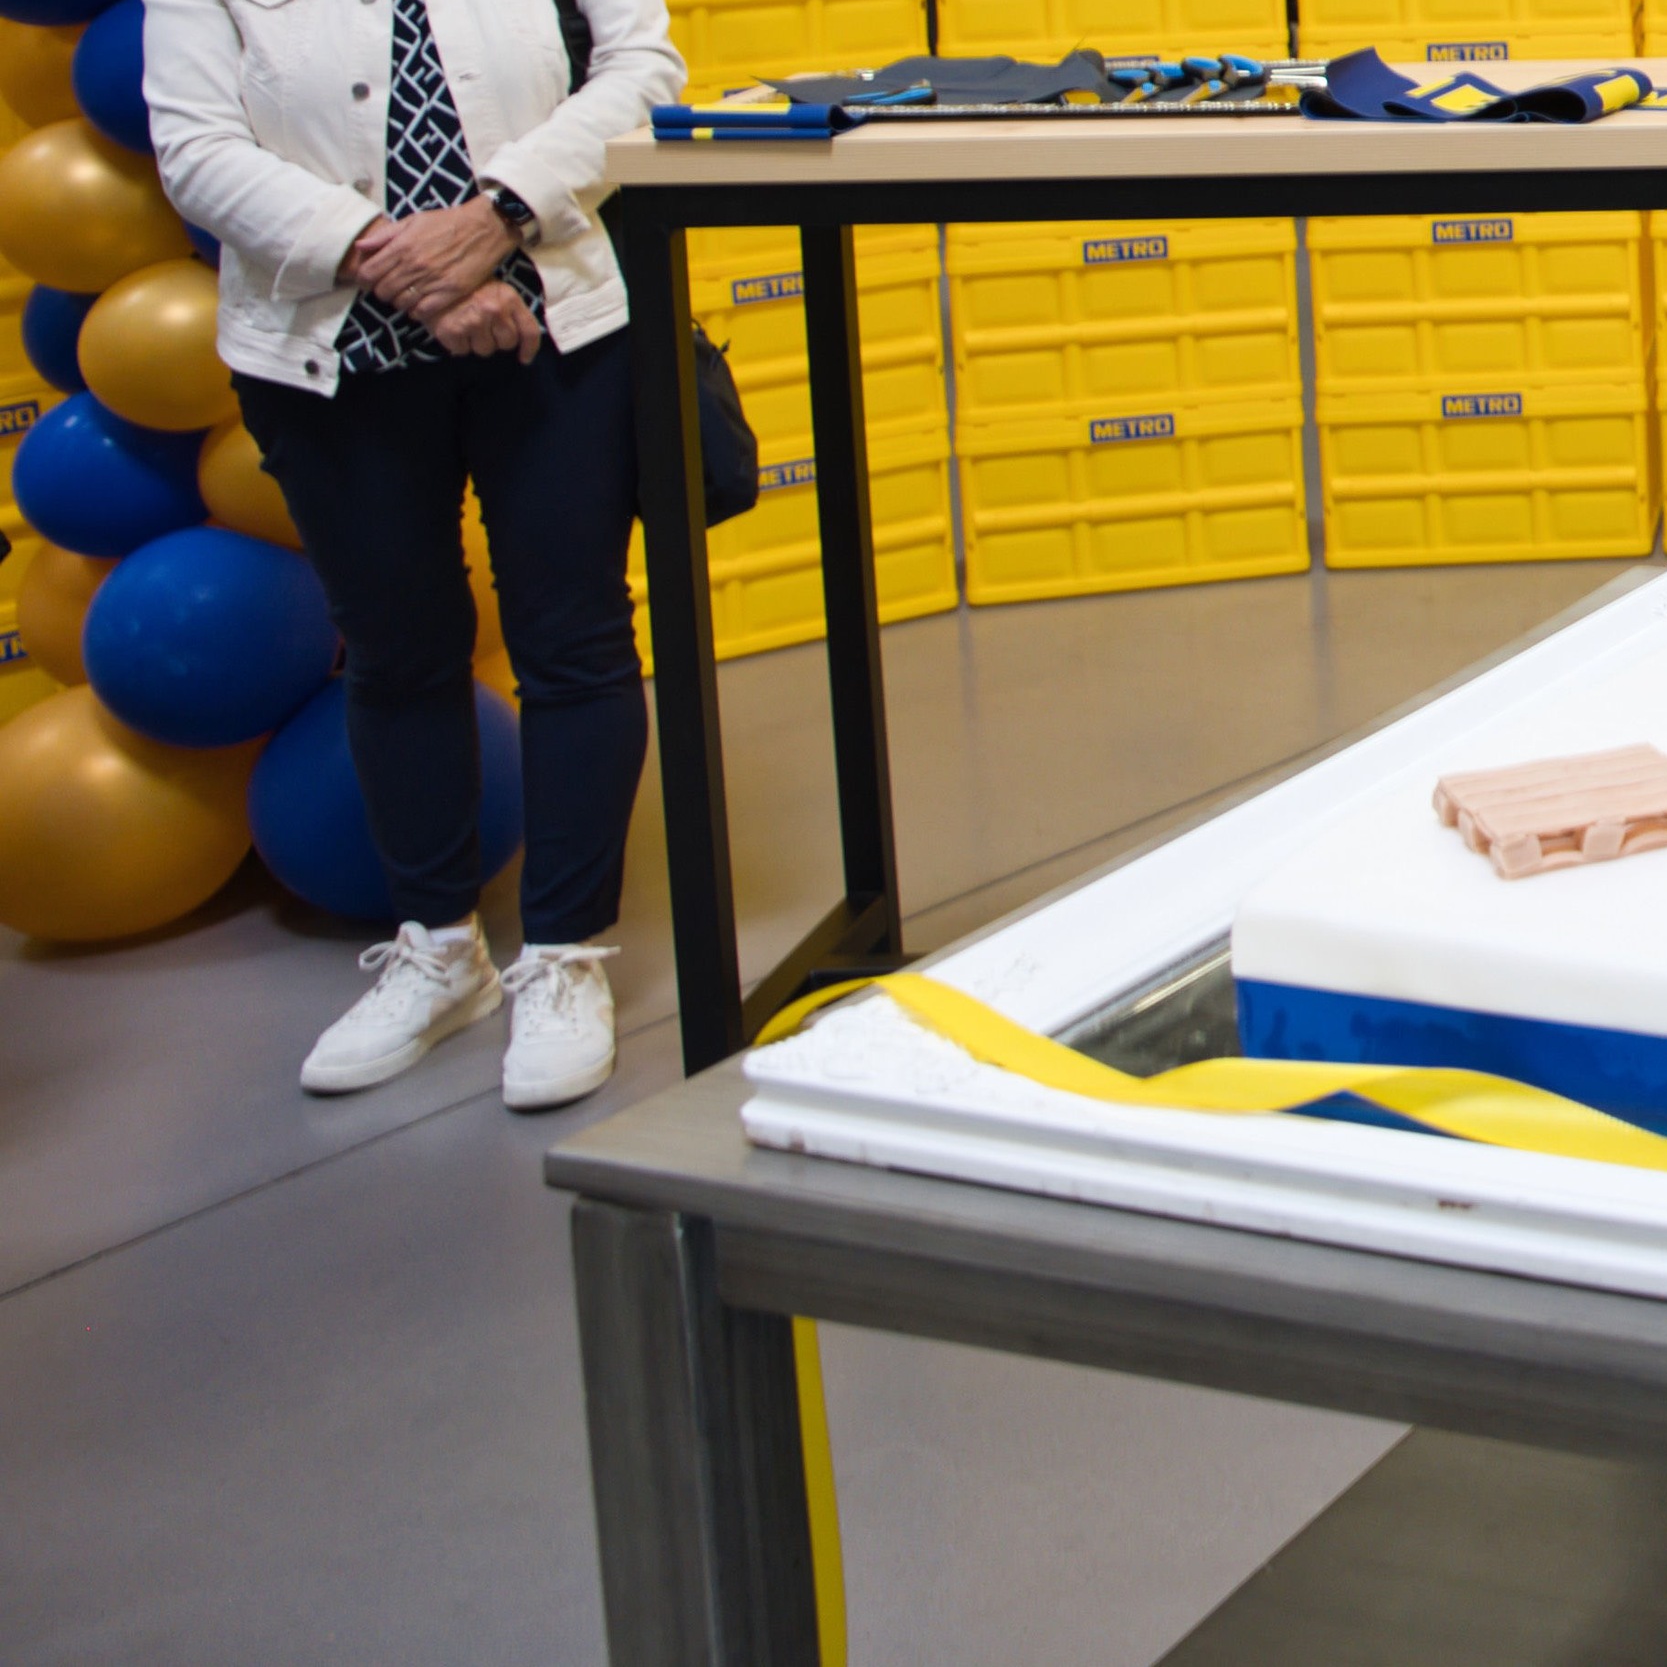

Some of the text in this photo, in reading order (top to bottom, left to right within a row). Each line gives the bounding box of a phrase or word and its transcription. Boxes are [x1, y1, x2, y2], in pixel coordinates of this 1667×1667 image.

[1430, 44, 1505, 60] METRO
[1436, 222, 1510, 239] METRO
[1087, 240, 1165, 259] METRO
[736, 275, 802, 299] METR
[1445, 397, 1519, 413] METRO
[1093, 418, 1171, 438] METRO
[760, 460, 813, 486] ETR
